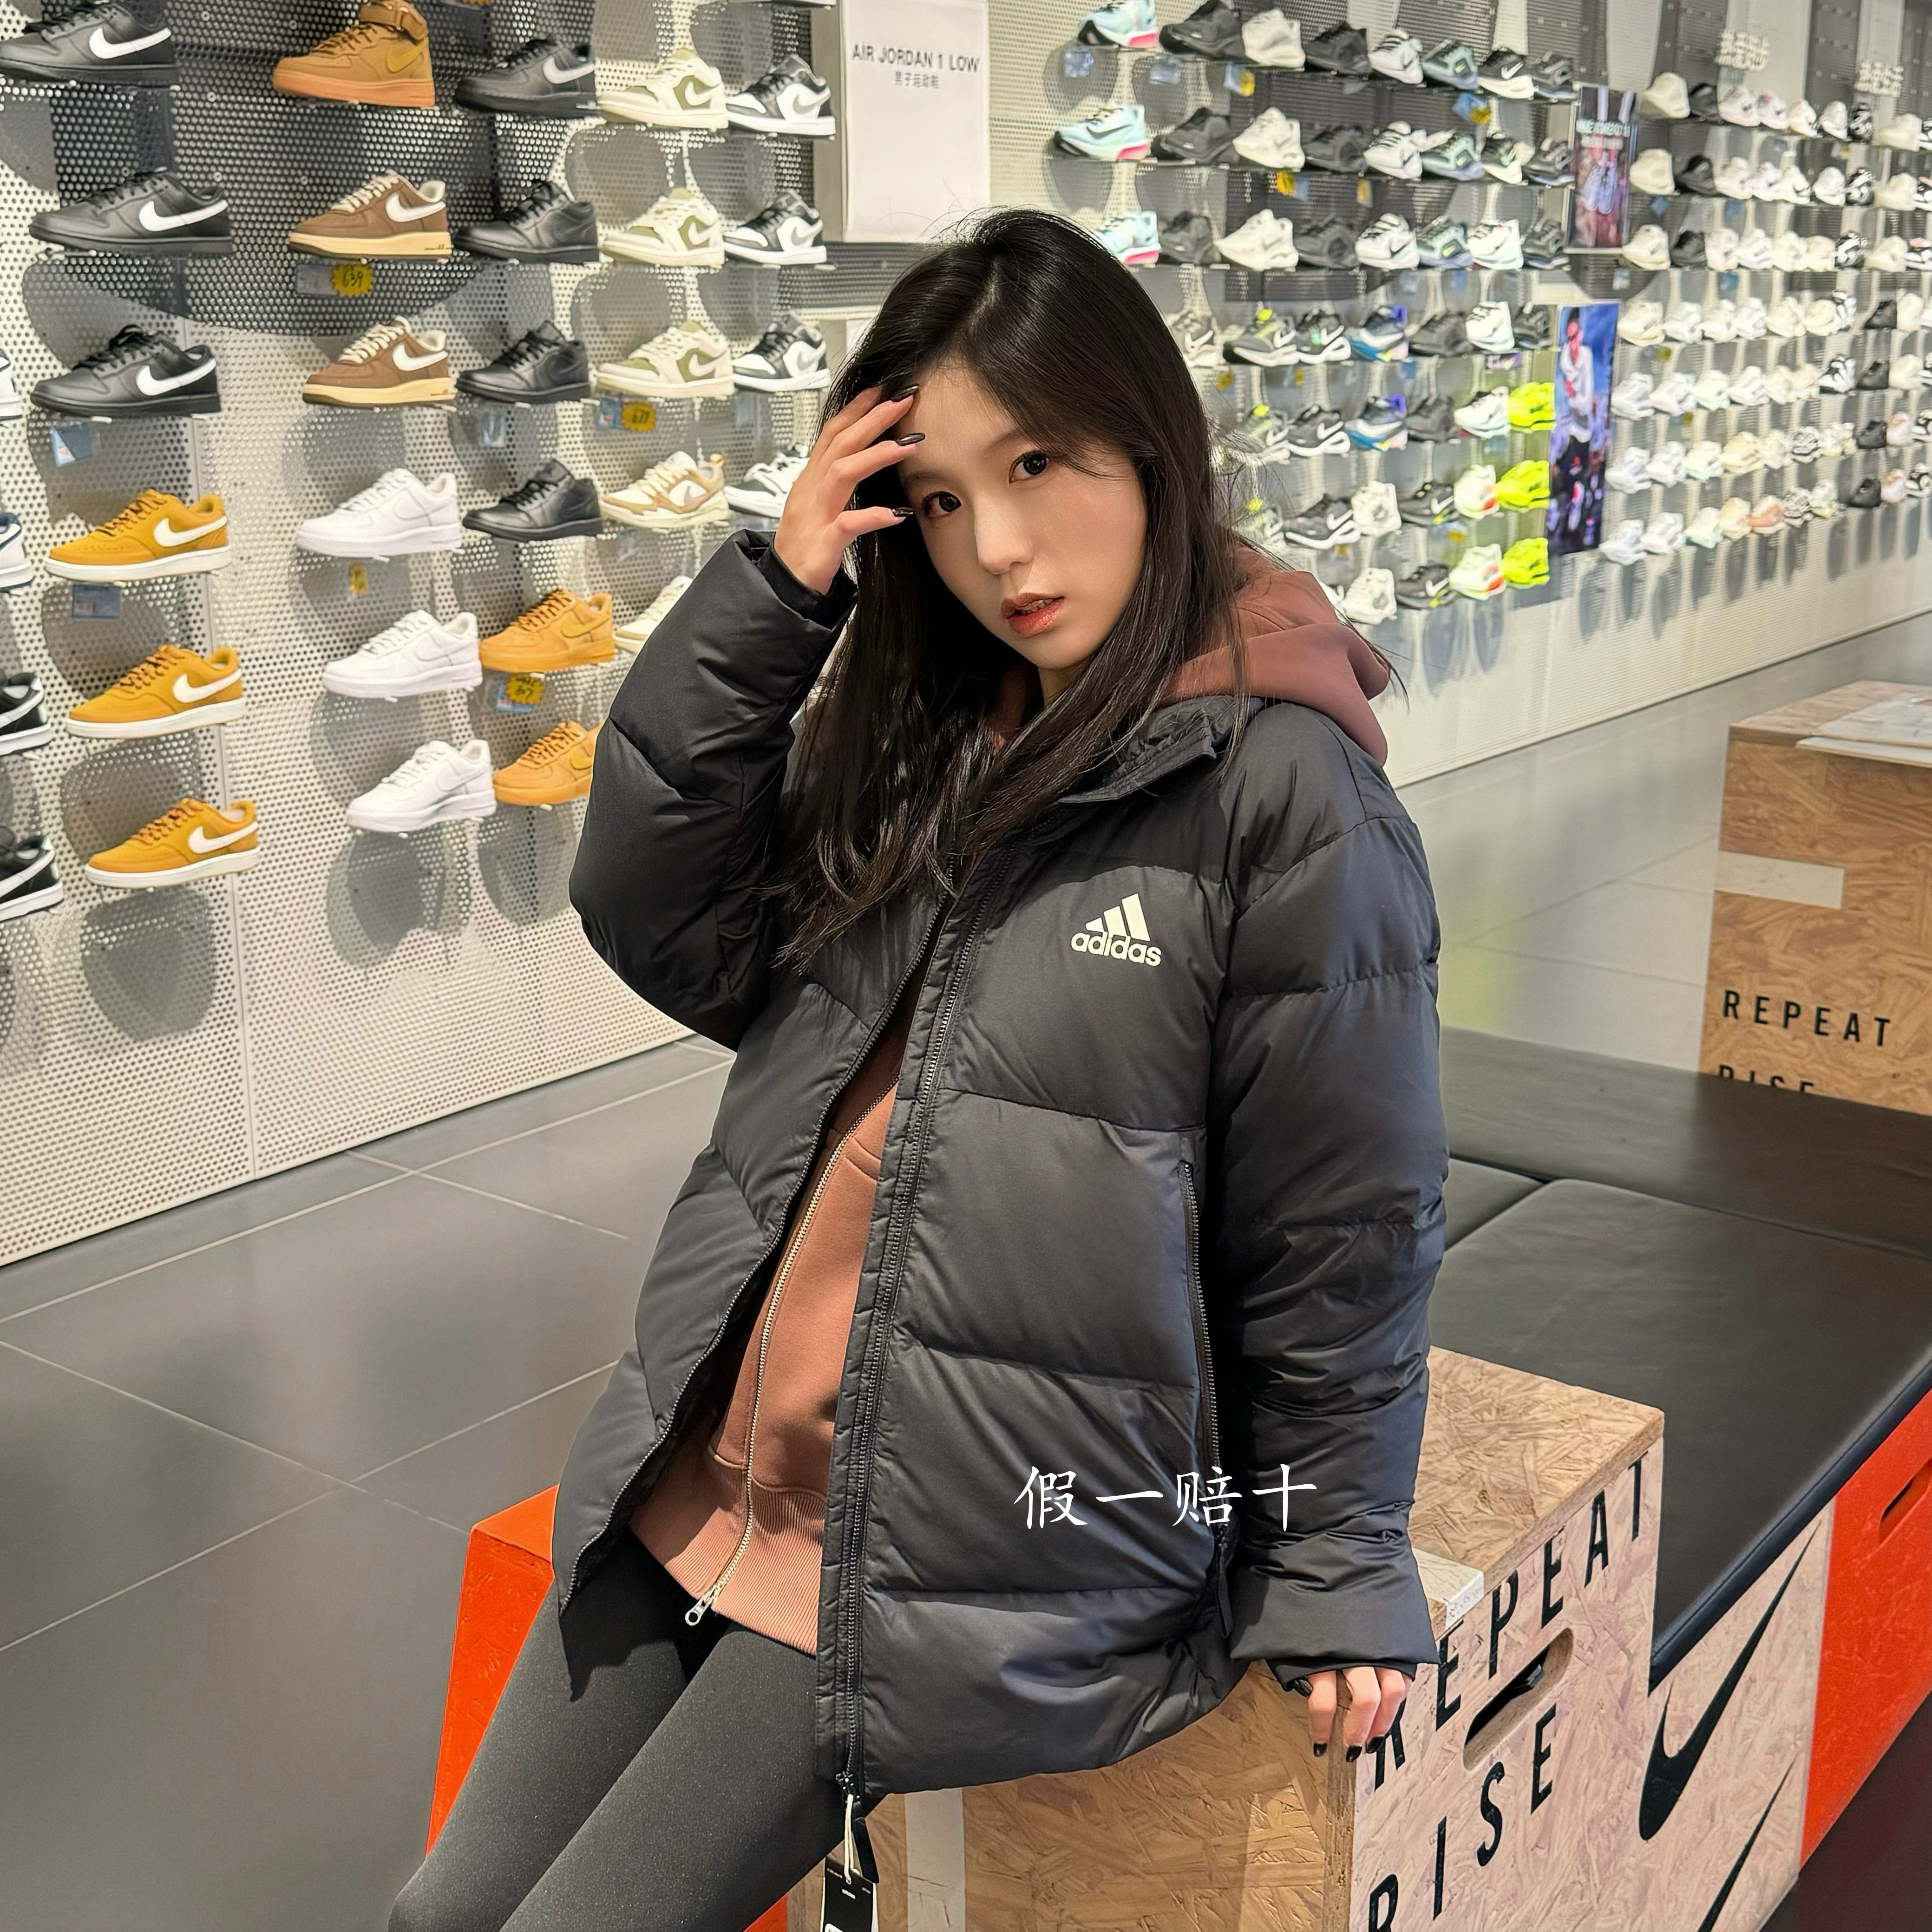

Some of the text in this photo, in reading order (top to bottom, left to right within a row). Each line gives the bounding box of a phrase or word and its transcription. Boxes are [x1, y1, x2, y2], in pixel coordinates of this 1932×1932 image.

[852, 44, 980, 72] AIR JORDAN 1 LOW
[1071, 931, 1162, 966] adidas
[1722, 989, 1891, 1047] REPEAT
[1368, 1703, 1557, 1932] RISE
